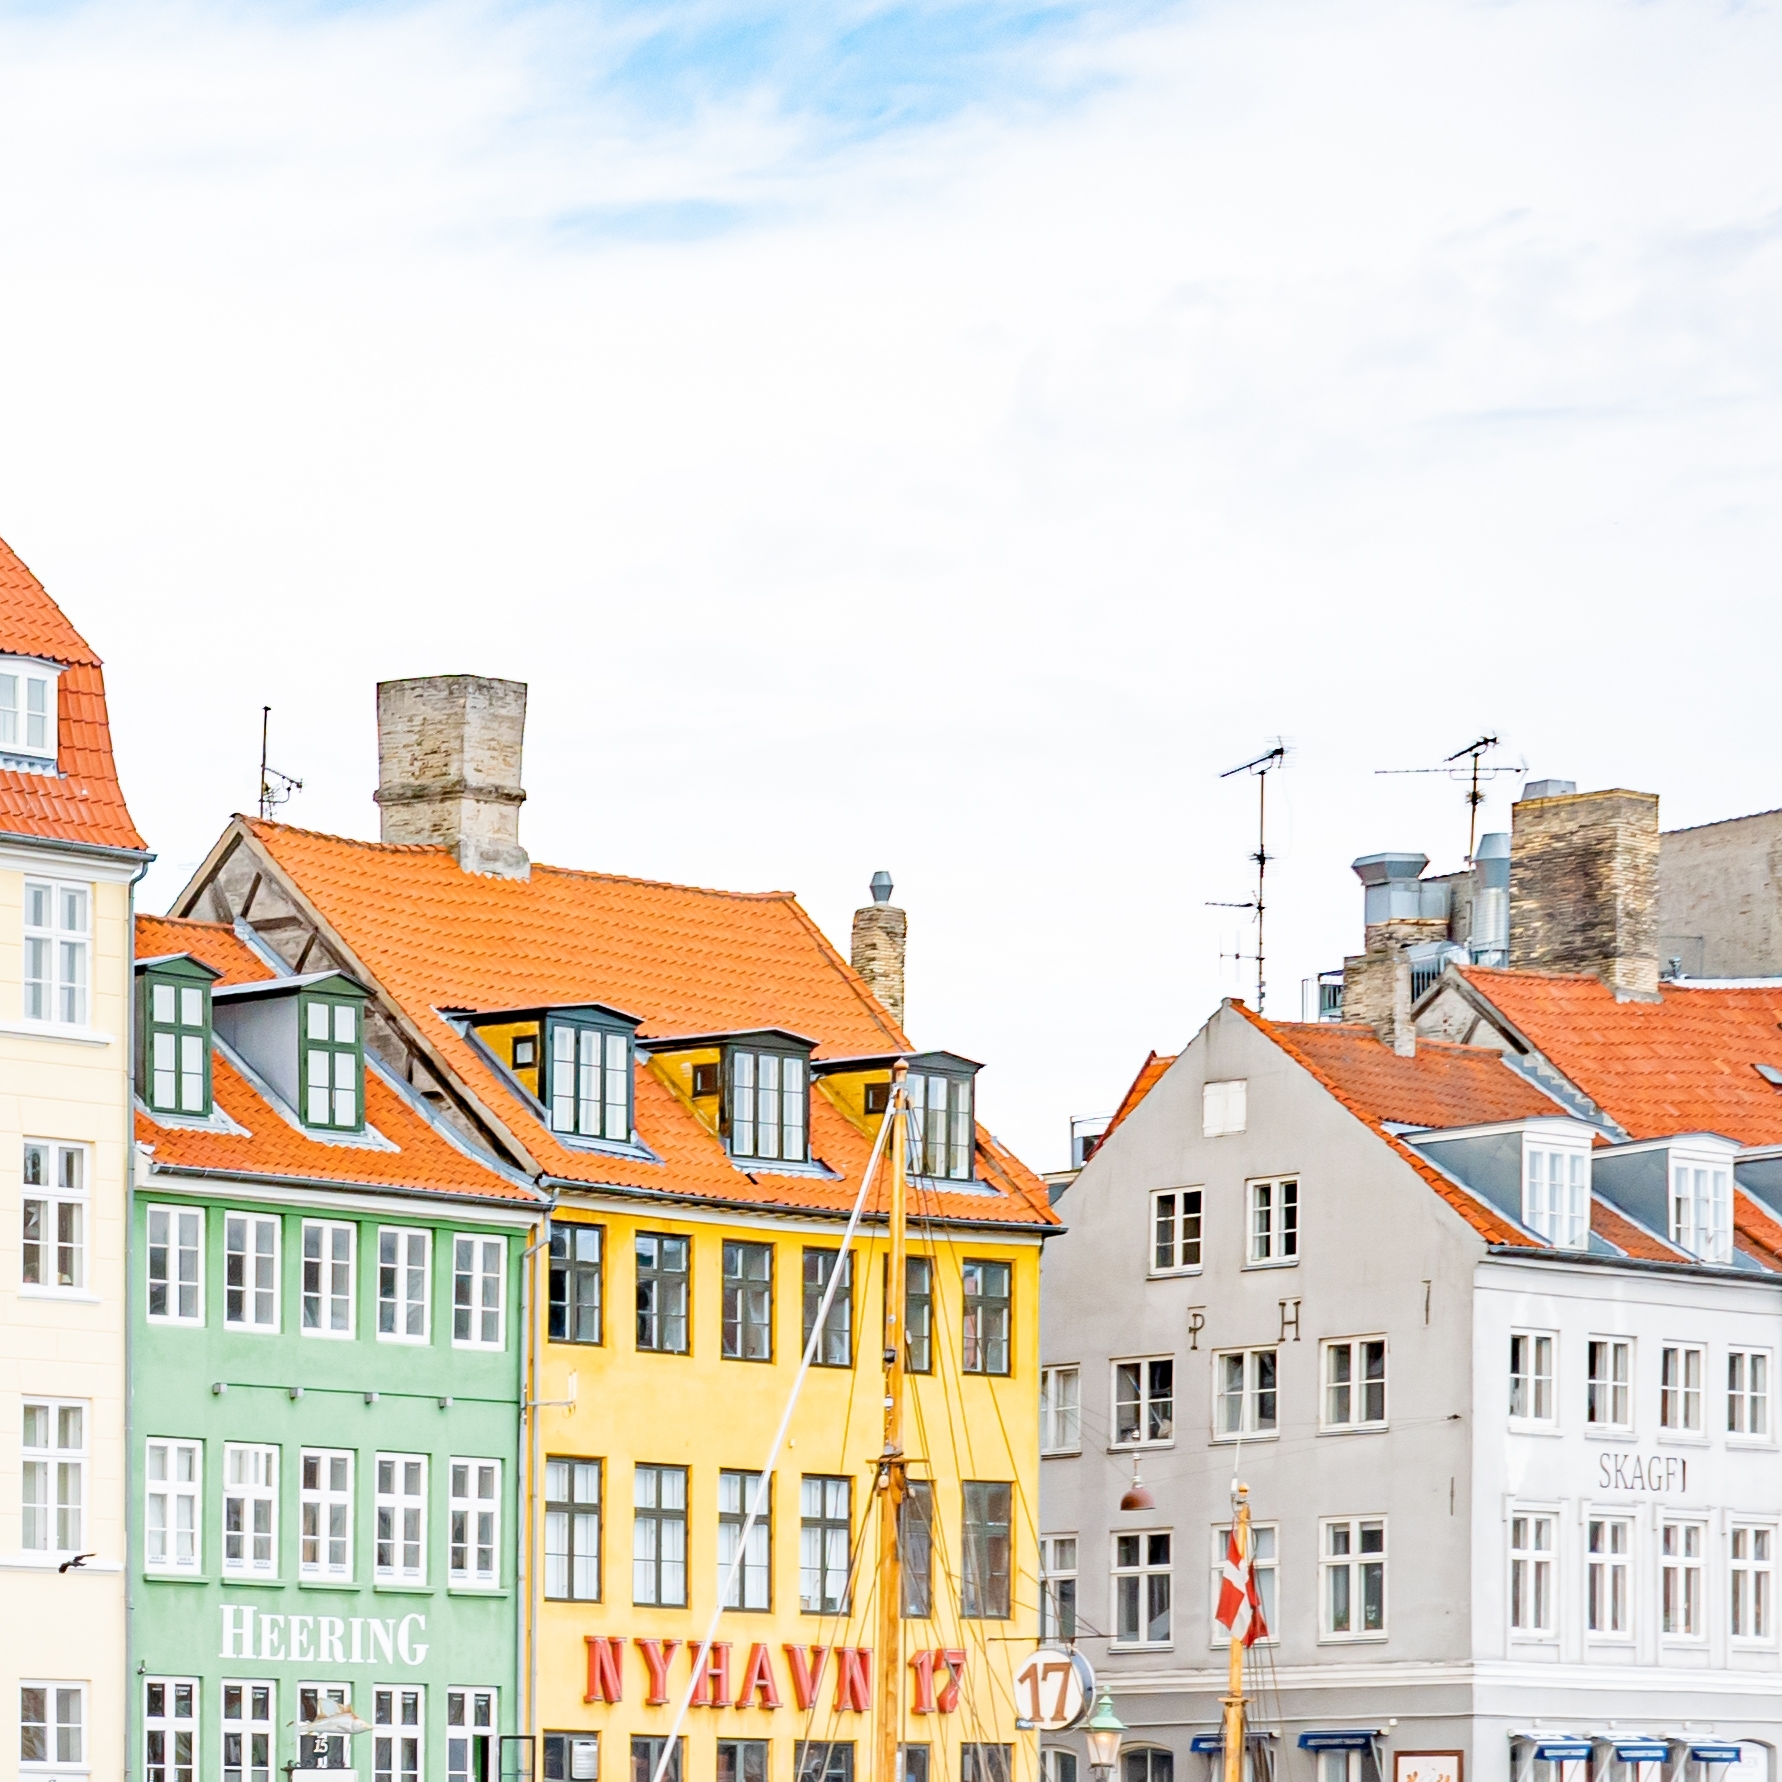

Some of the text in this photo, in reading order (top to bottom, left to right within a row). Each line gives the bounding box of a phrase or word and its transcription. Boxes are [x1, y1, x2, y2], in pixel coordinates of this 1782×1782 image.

[219, 1603, 429, 1666] HEERING
[583, 1635, 967, 1714] NYHAVN 17
[1018, 1662, 1072, 1722] 17
[313, 1736, 329, 1753] 15
